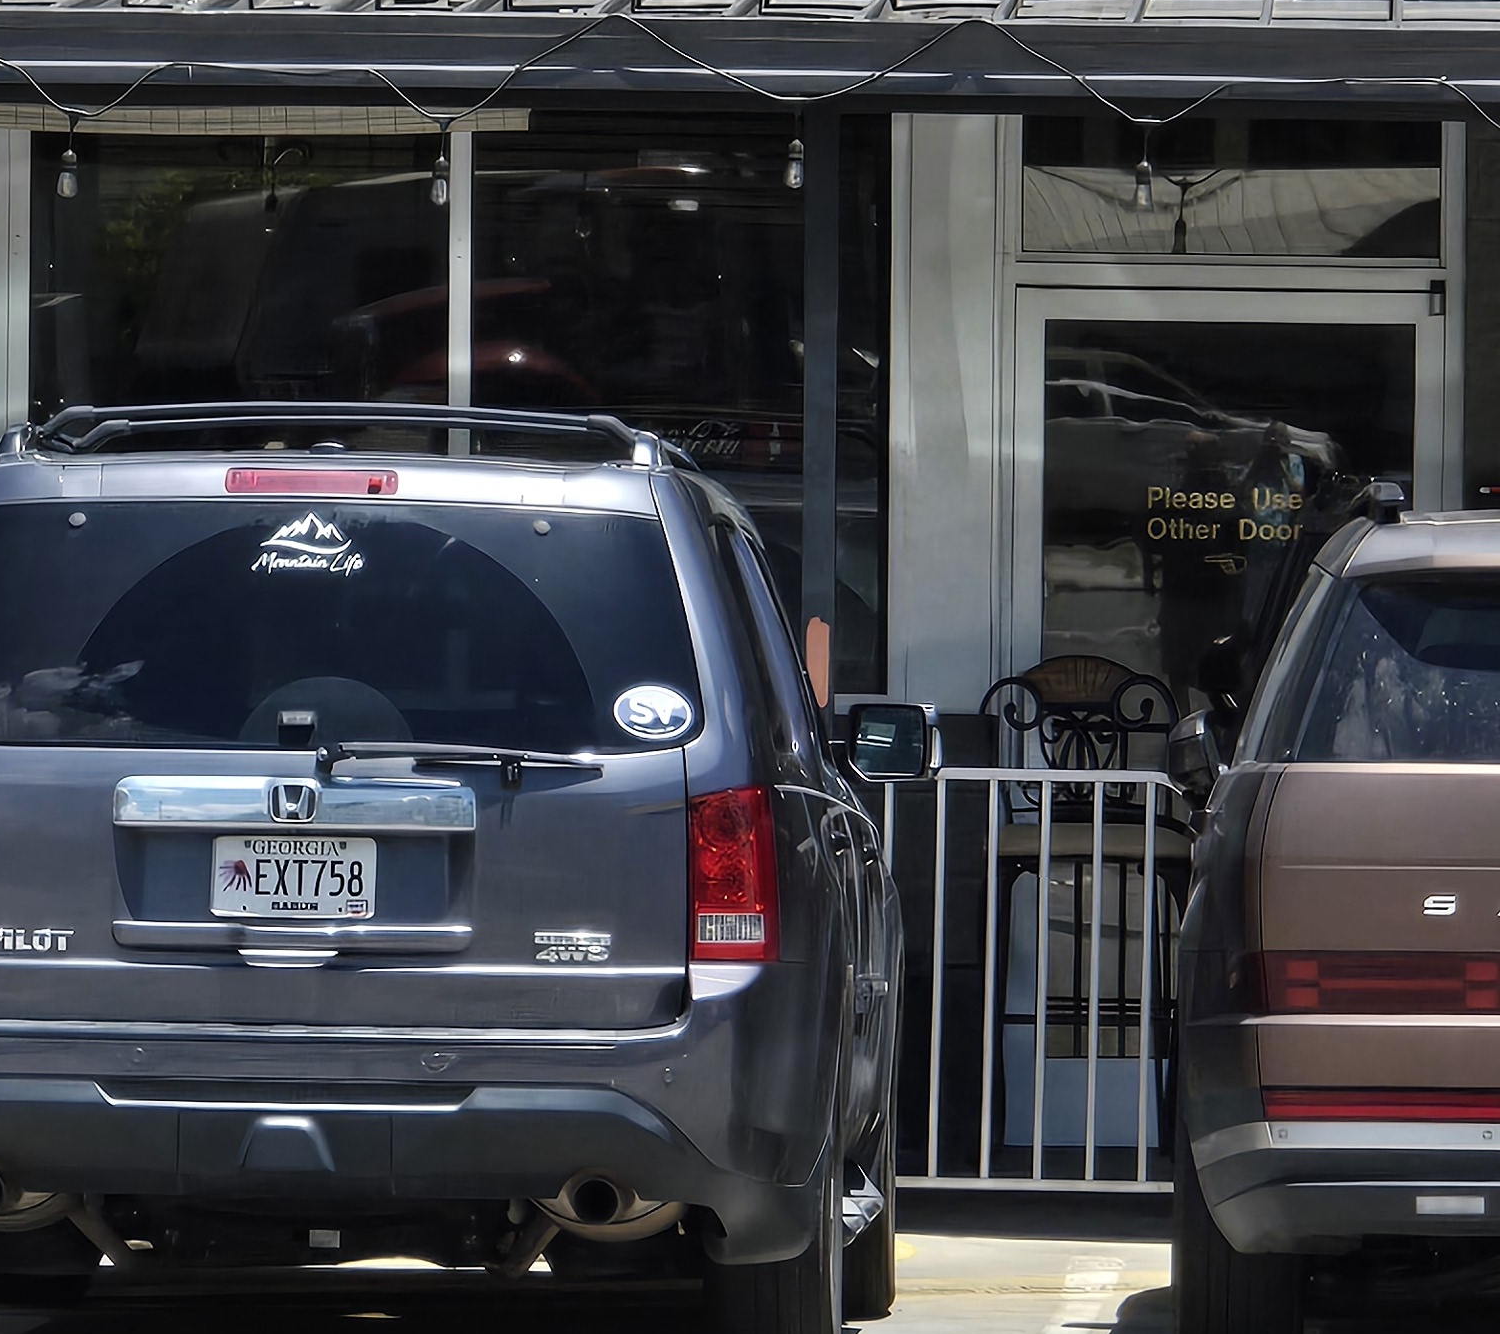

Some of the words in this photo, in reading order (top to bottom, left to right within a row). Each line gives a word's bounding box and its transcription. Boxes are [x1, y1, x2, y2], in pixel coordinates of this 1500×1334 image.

[1147, 486, 1236, 510] Please
[1253, 487, 1303, 511] Use
[1147, 517, 1221, 541] Other
[1238, 518, 1304, 542] Door
[251, 551, 328, 574] Mountain
[252, 840, 339, 856] GEORGIA
[255, 859, 364, 897] EXT758
